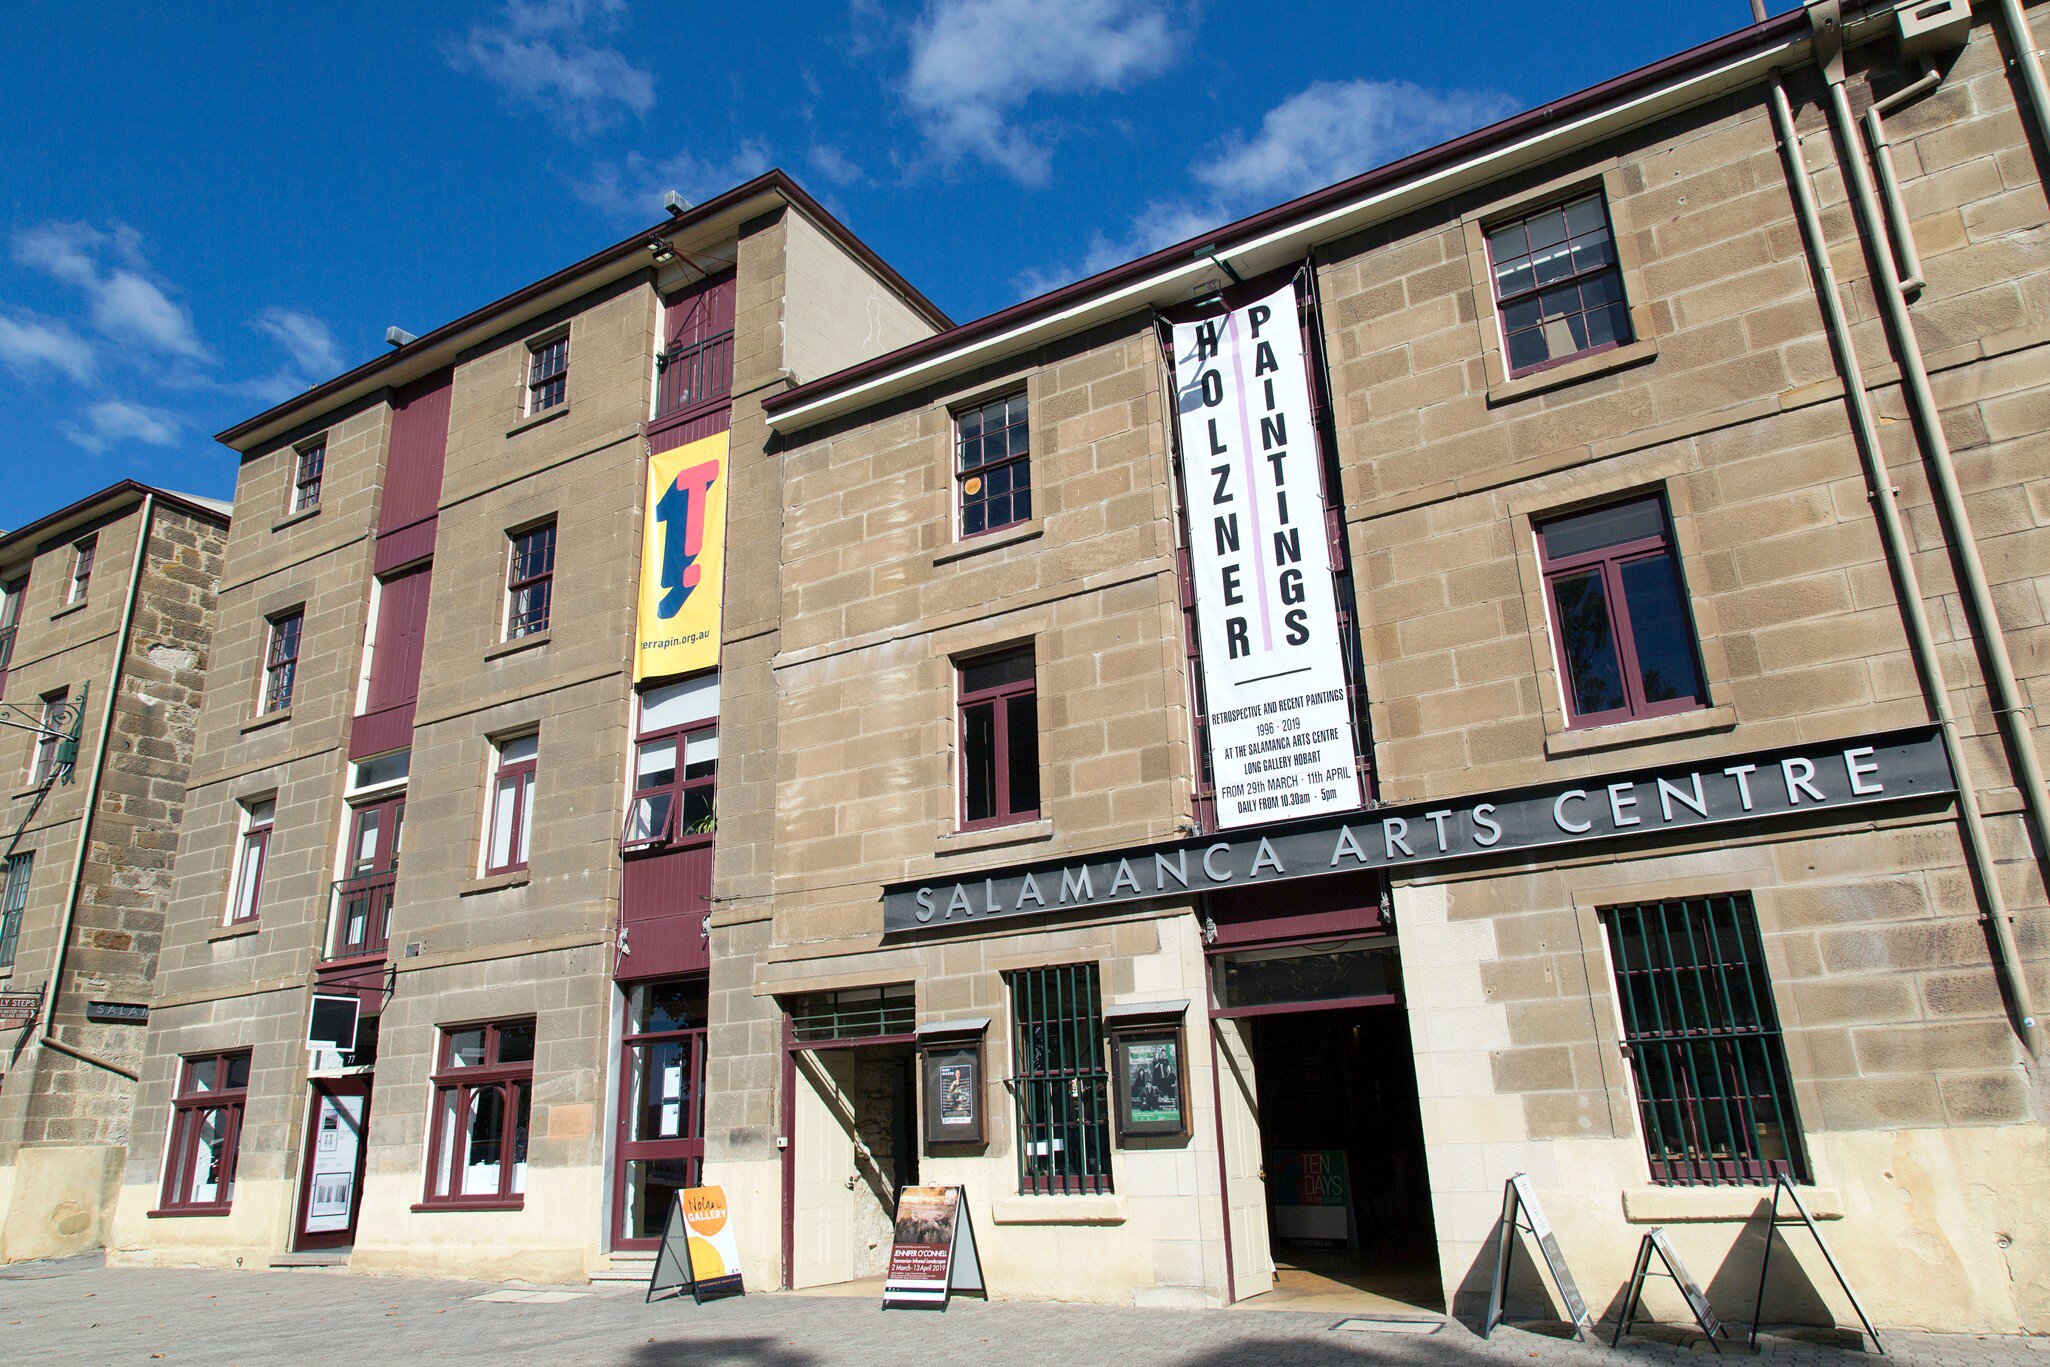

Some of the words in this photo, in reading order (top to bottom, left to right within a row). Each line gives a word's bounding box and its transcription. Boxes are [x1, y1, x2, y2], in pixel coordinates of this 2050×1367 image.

[1247, 304, 1310, 646] PAINTINGS
[1195, 320, 1250, 660] HOLZNER
[1212, 705, 1261, 725] RETROSPECTIVE
[1263, 700, 1277, 715] AND
[1279, 696, 1304, 712] RECENT
[1306, 688, 1344, 706] PAINTINGS
[1257, 722, 1274, 738] 1996
[1282, 717, 1301, 732] 2019
[1224, 748, 1233, 760] AT
[1235, 745, 1247, 758] THE
[1249, 736, 1291, 756] SALAMANCA
[1293, 733, 1311, 748] ARTS
[1312, 727, 1339, 744] CENTRE
[1244, 761, 1261, 775] LONG
[1263, 755, 1292, 772] GALLERY
[1294, 750, 1321, 766] HOBART
[1221, 784, 1245, 799] FROM
[1247, 781, 1265, 795] 29th
[1267, 775, 1299, 791] MARCH
[1307, 771, 1323, 785] 11th
[1326, 766, 1351, 782] APRIL
[1237, 800, 1257, 814] DAILY
[1259, 796, 1279, 810] FROM
[1280, 792, 1311, 808] 10.30am
[1321, 788, 1337, 803] 5pm
[914, 836, 1285, 923] SALAMANCA
[1329, 804, 1501, 867] ARTS
[1553, 746, 1884, 834] CENTRE
[12, 999, 36, 1007] STEPS
[347, 1055, 356, 1065] 77
[1301, 1153, 1331, 1174] TEN
[1305, 1175, 1342, 1196] DAYS
[688, 1209, 726, 1222] GALLERY
[894, 1249, 917, 1257] JENNIFER
[917, 1249, 947, 1257] O'CONNELL
[920, 1264, 932, 1273] April
[932, 1264, 947, 1272] 2019
